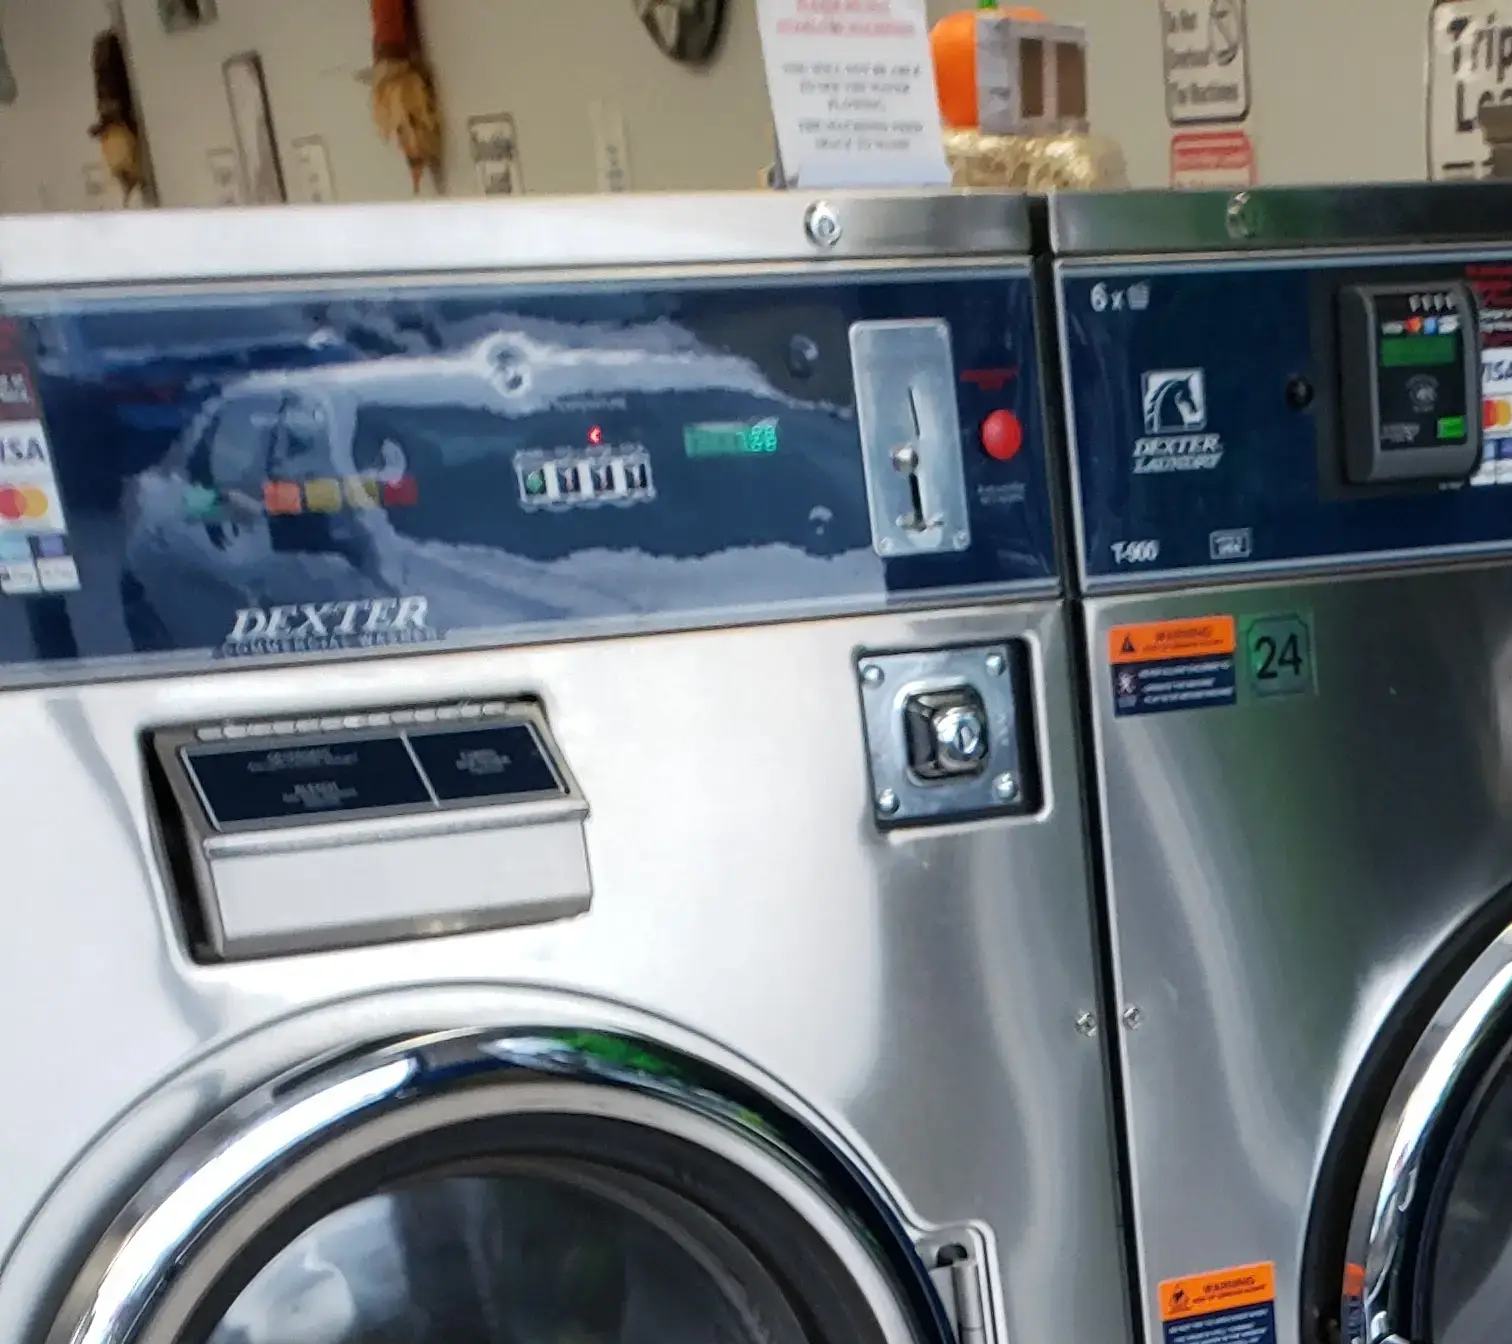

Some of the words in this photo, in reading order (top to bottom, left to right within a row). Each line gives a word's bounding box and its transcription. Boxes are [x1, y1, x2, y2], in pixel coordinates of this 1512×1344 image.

[0, 436, 46, 463] ISA
[1133, 433, 1222, 457] DEXTER
[226, 595, 429, 642] DEXTER
[1255, 632, 1303, 680] 24
